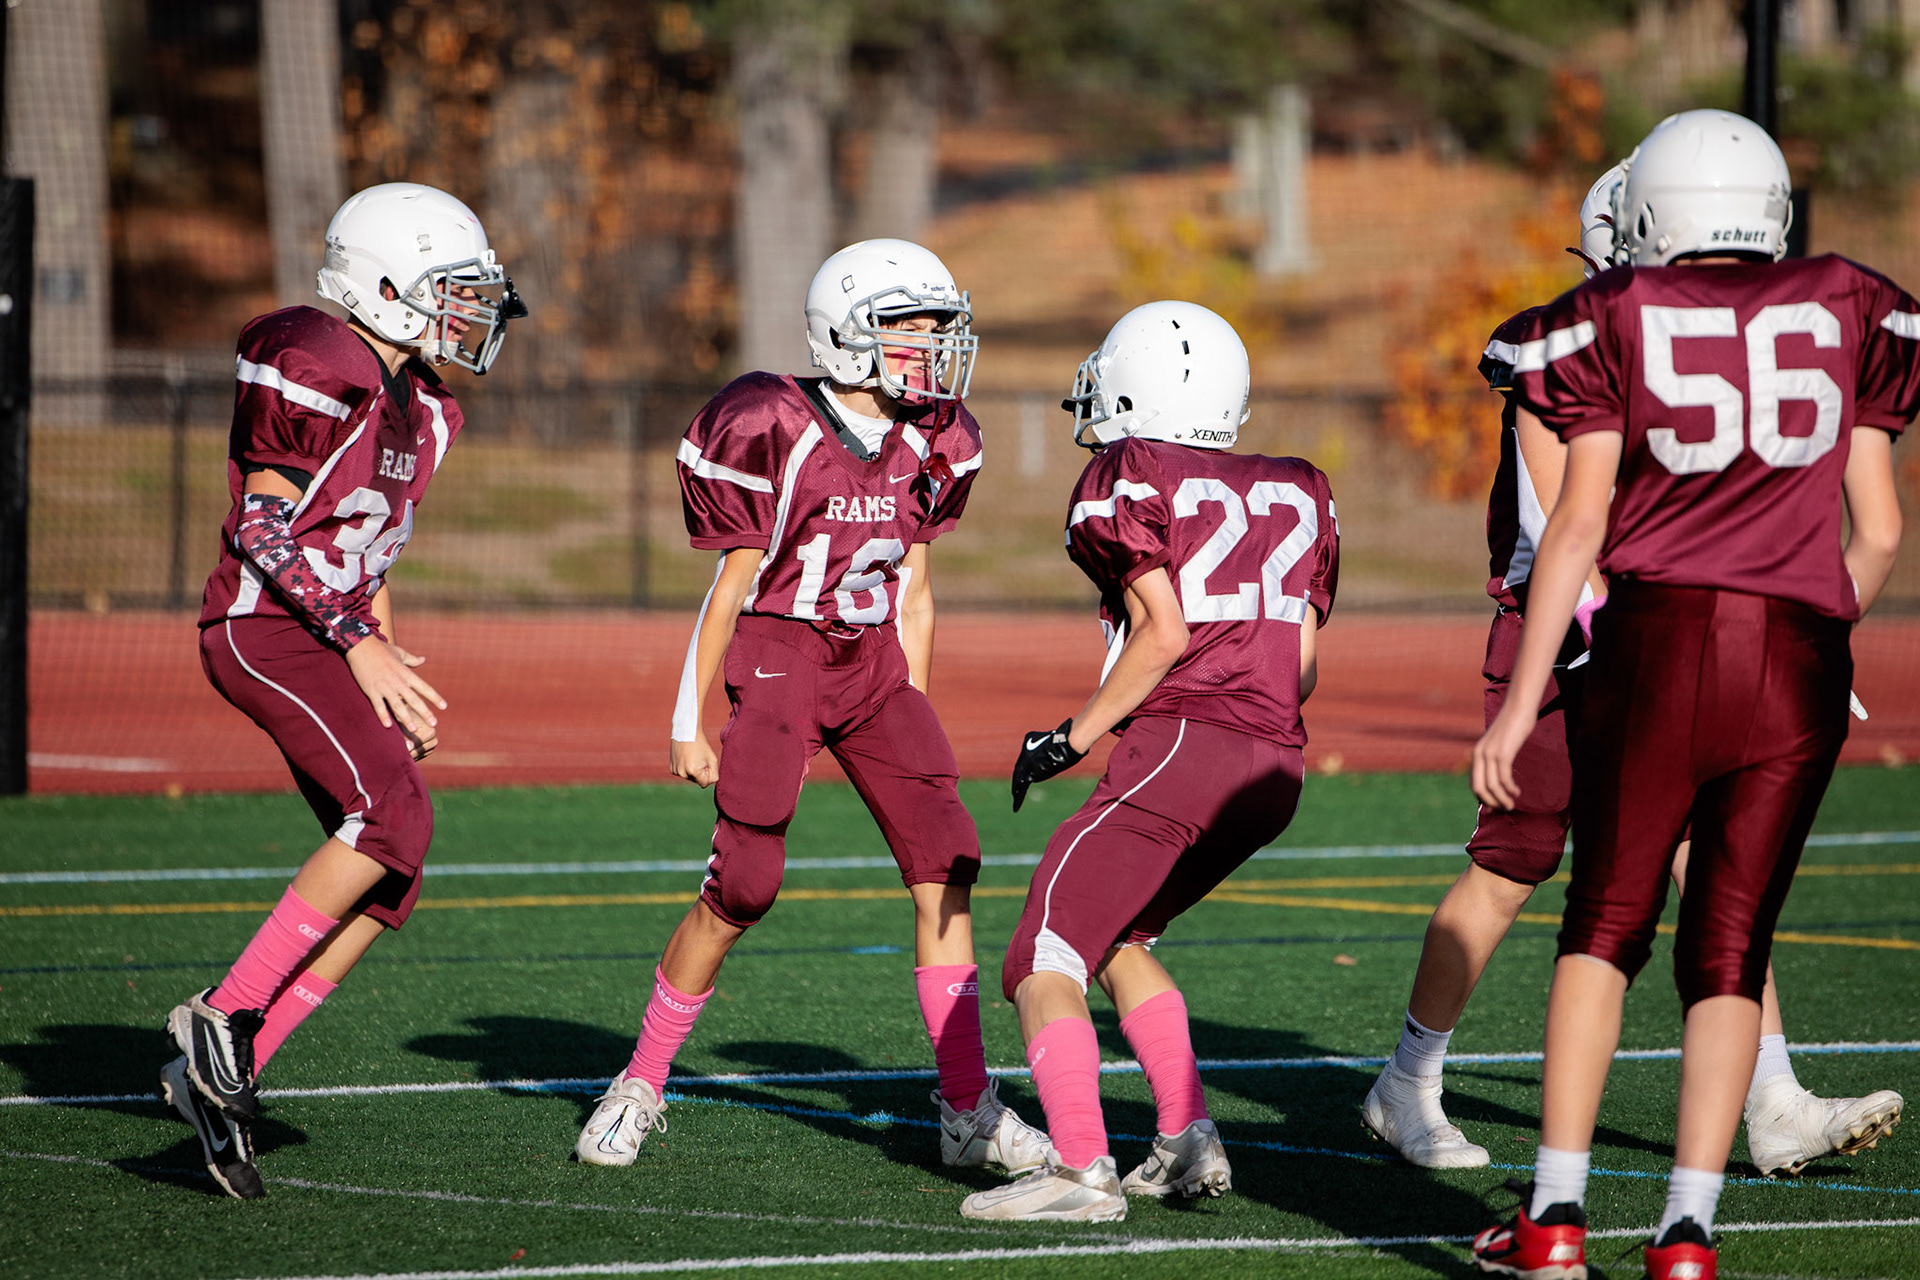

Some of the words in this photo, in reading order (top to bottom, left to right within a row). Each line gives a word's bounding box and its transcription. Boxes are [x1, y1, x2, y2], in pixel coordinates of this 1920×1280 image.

[1189, 428, 1235, 442] XENITH
[1640, 301, 1843, 476] 56
[824, 496, 897, 523] RAMS
[1172, 477, 1319, 625] 22
[784, 533, 906, 626] 16
